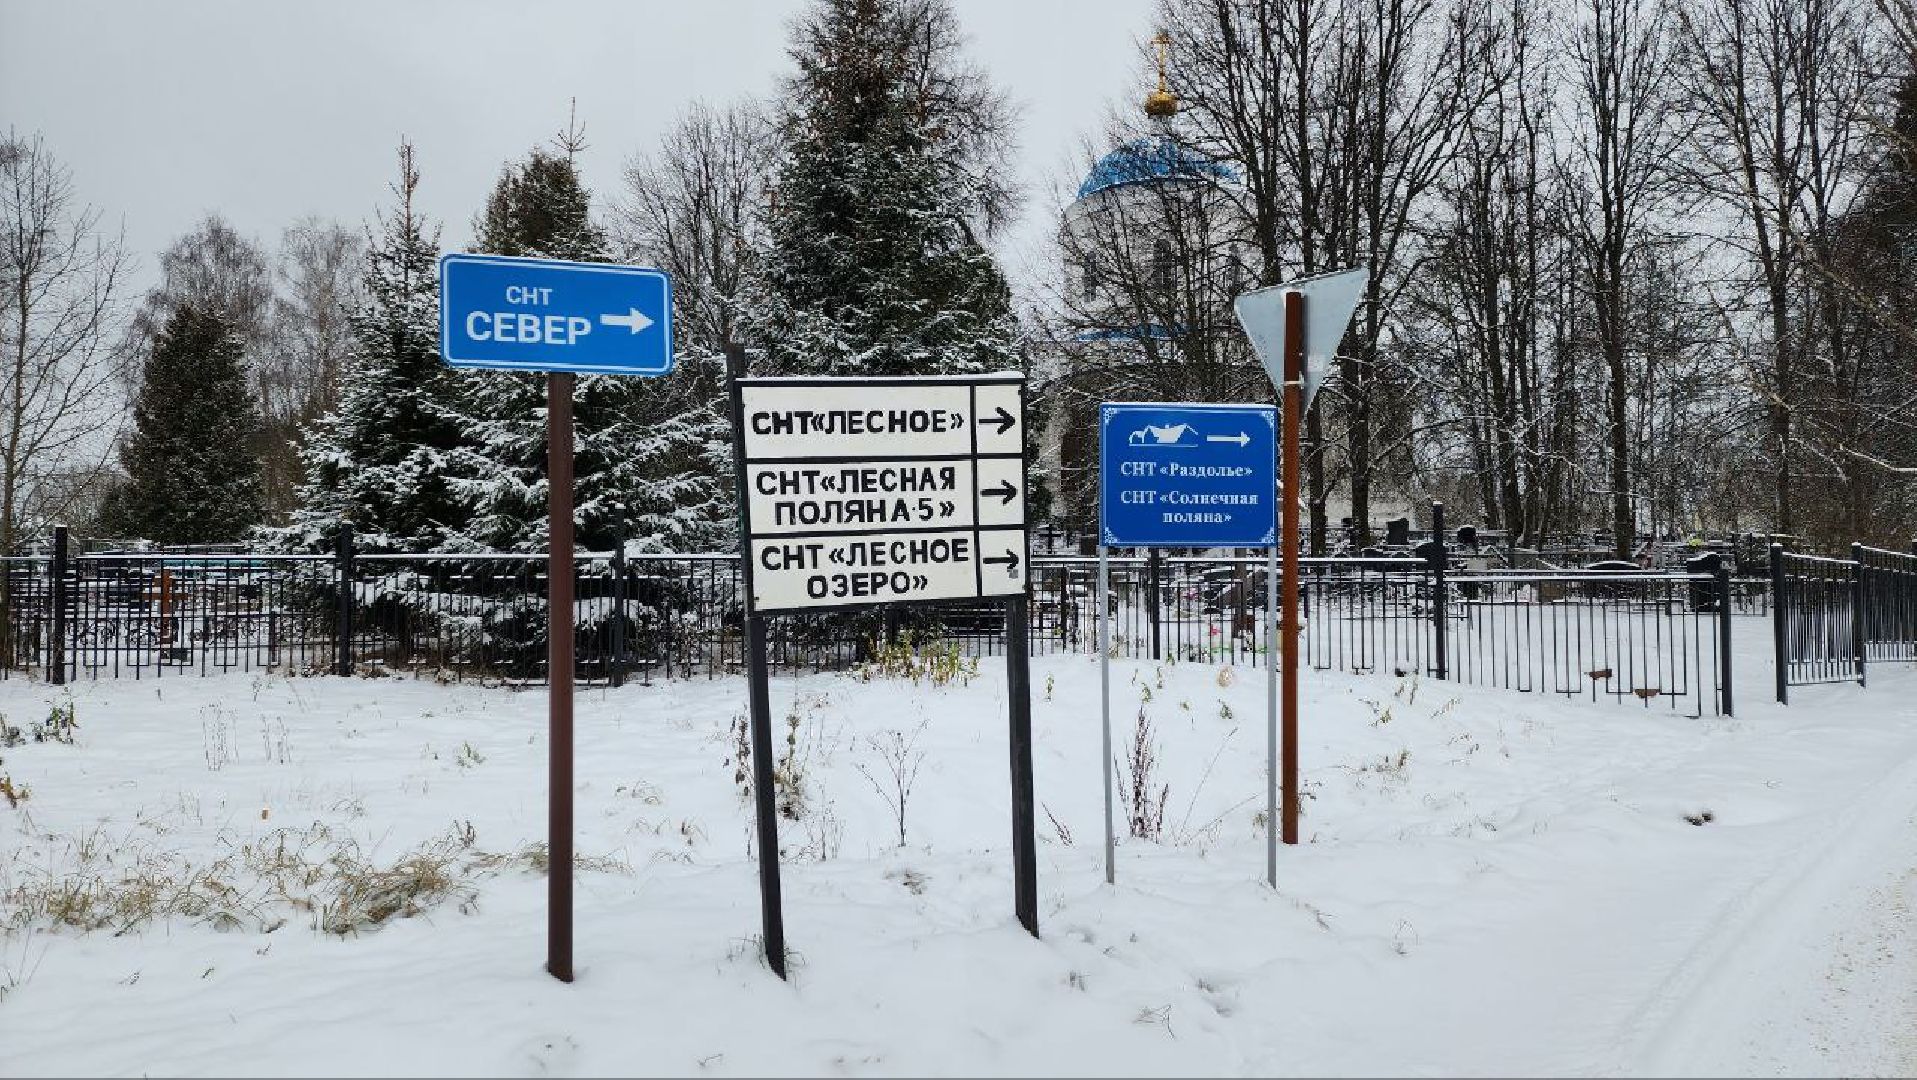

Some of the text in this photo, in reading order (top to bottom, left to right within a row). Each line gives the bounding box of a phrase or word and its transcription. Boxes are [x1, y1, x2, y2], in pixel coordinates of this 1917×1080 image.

[506, 286, 553, 306] СНТ
[466, 310, 592, 345] СЕВЕР
[1120, 461, 1253, 479] СНТ «Раздолье»
[1120, 490, 1259, 505] СНТ «Солнечная
[1162, 511, 1232, 524] поляна»
[761, 538, 969, 571] СНТ «ЛЕСНОЕ
[806, 571, 929, 599] ОЗЕРО»
